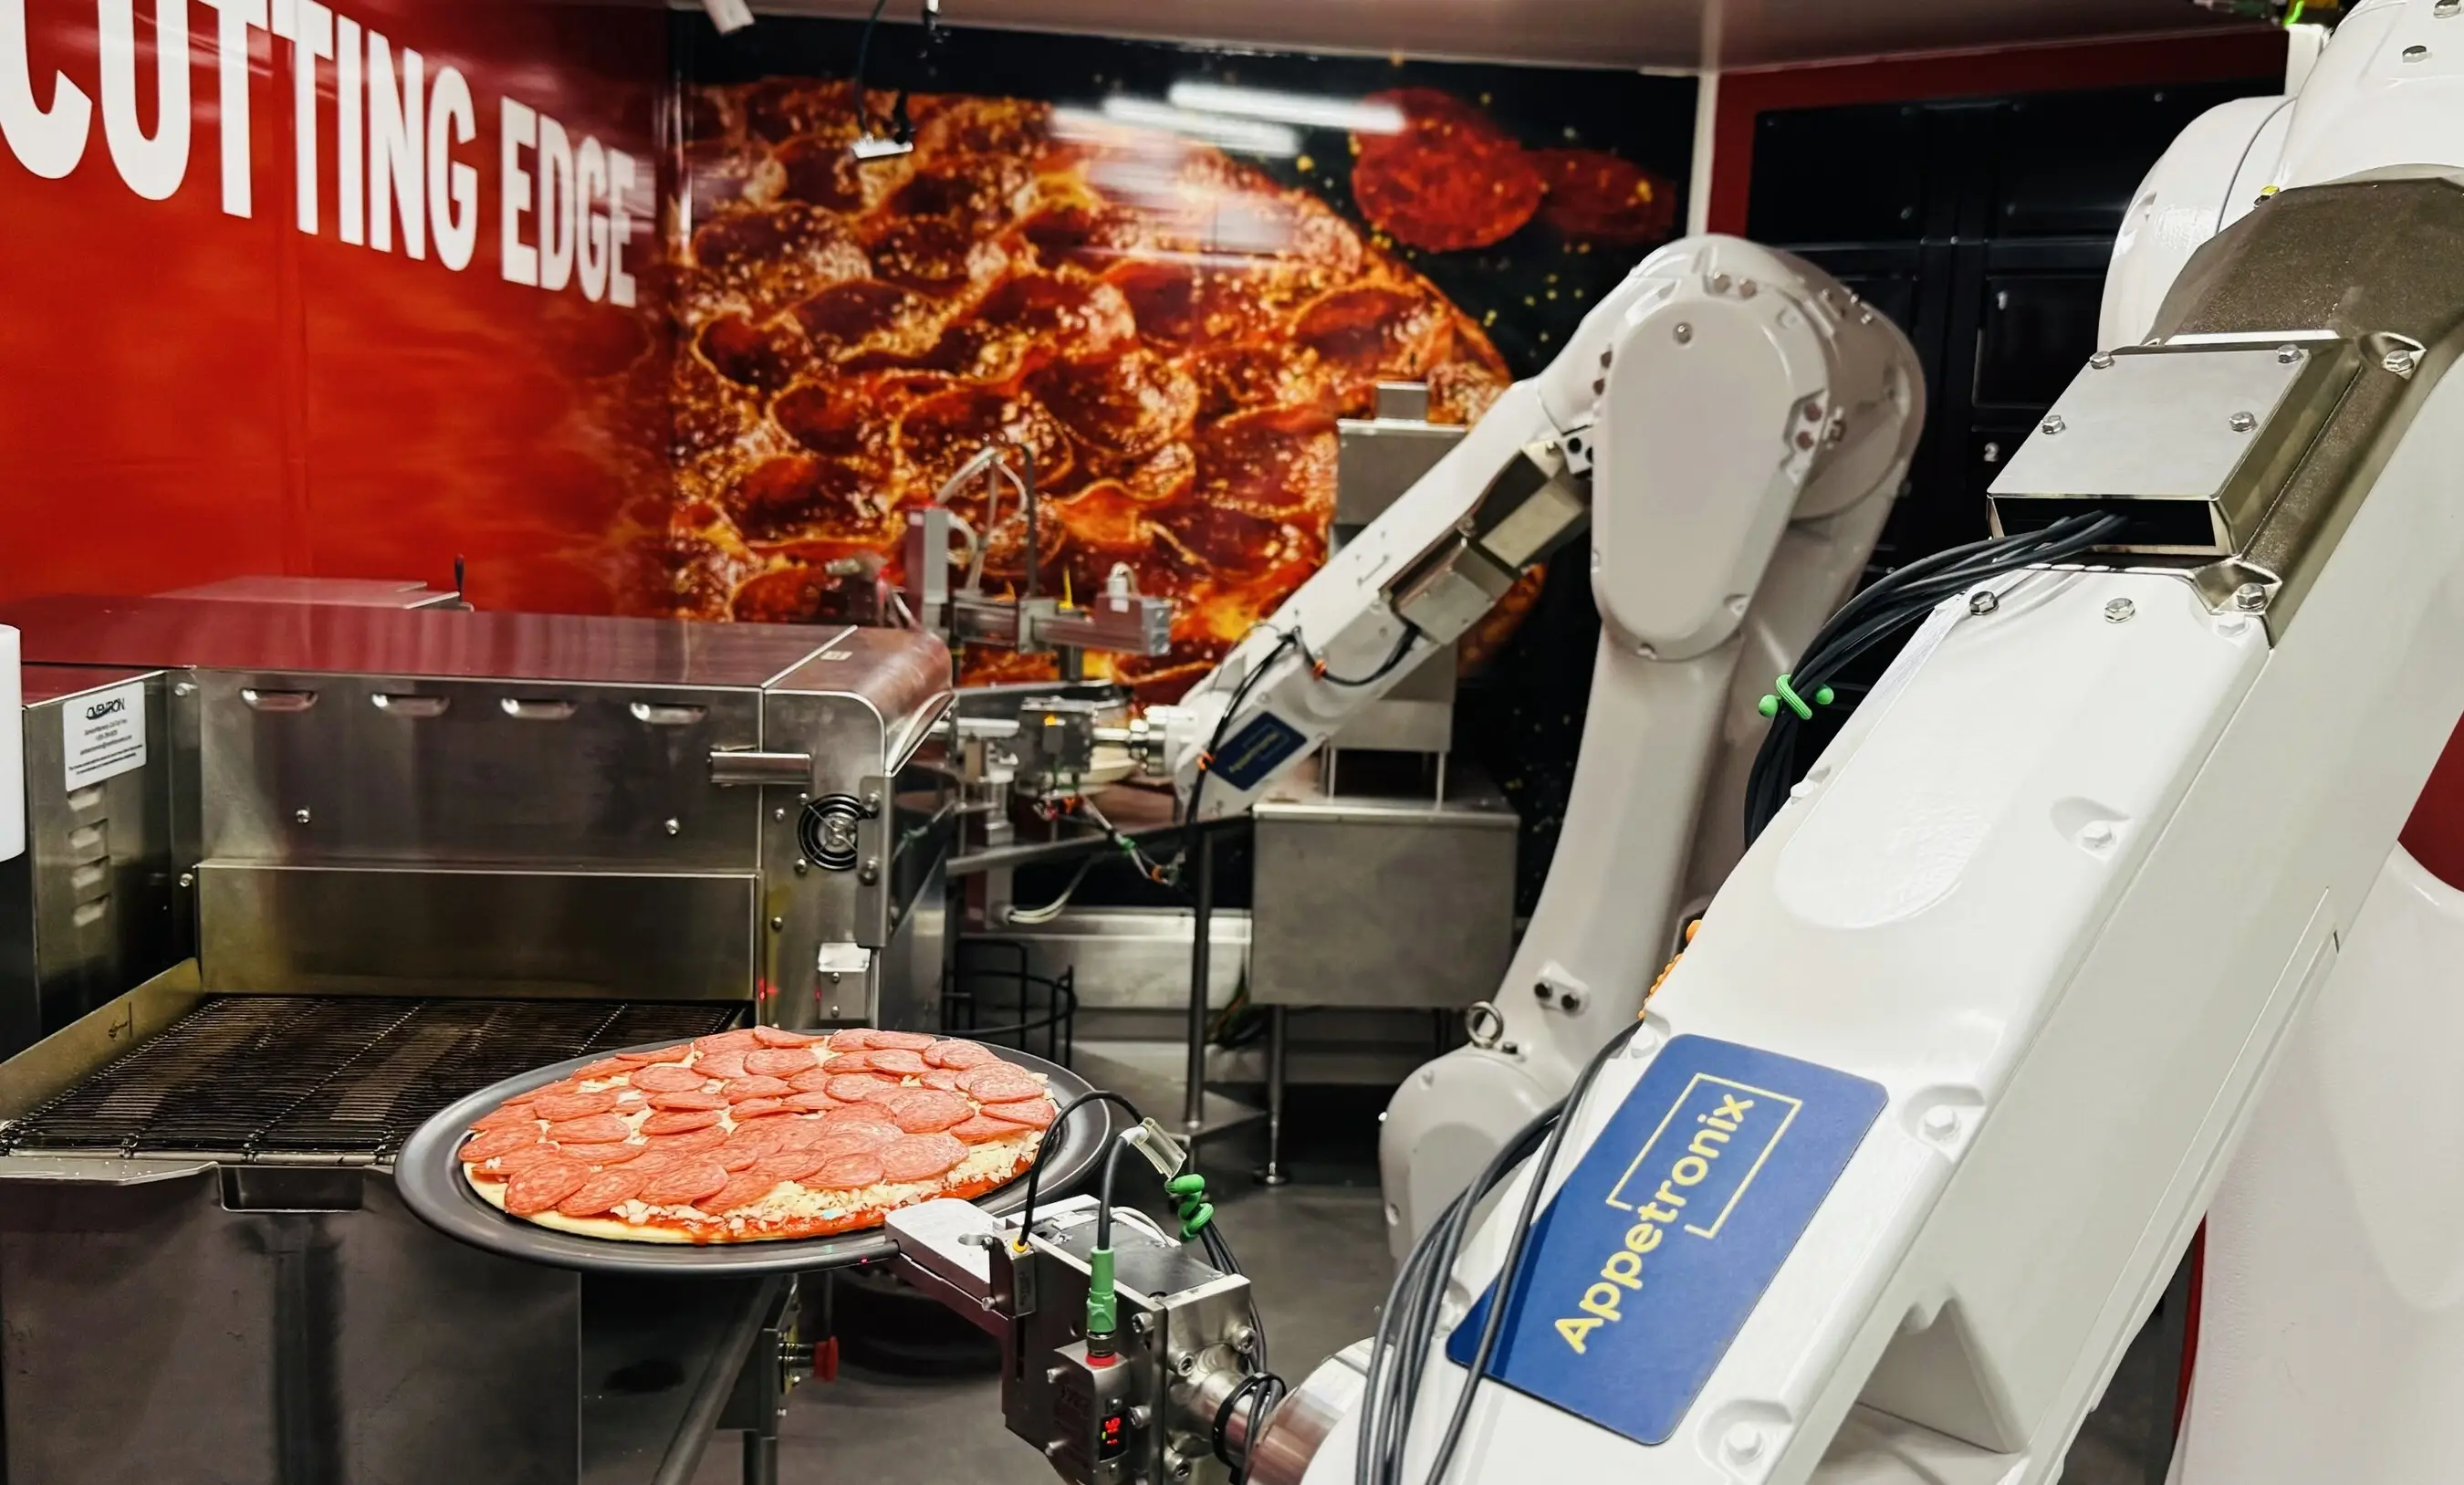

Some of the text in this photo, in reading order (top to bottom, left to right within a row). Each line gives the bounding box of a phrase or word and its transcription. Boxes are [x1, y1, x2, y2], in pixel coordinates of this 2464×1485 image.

[0, 0, 636, 309] CUTTING EDGE
[1984, 442, 1999, 462] 2
[1554, 1093, 1755, 1354] Appetronix
